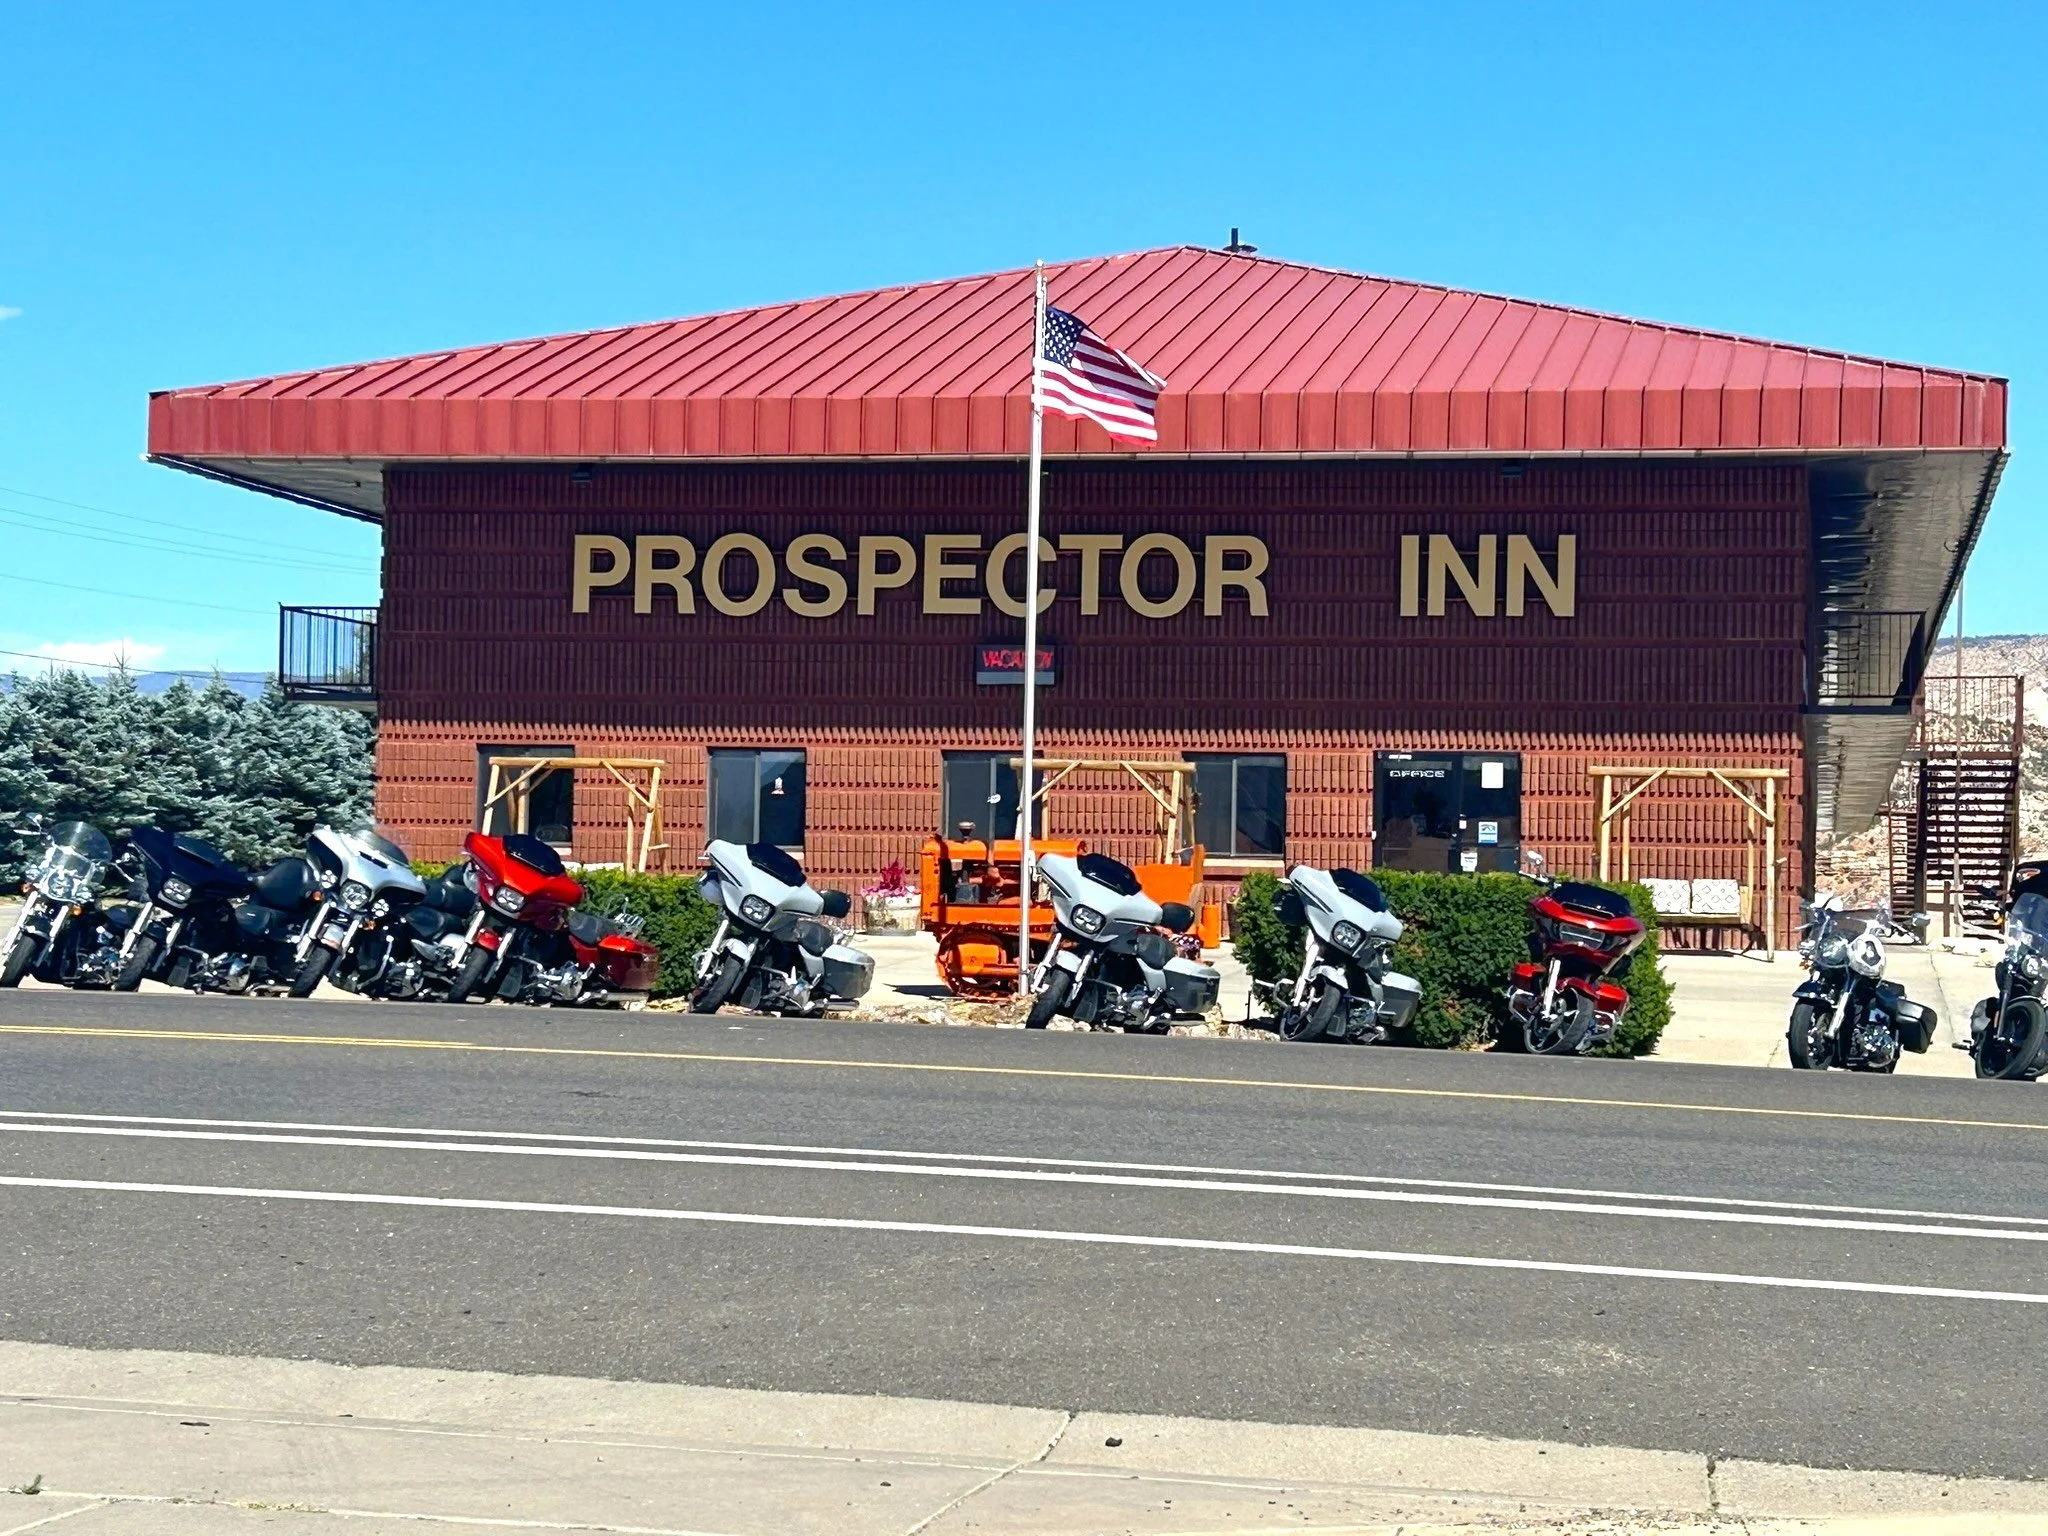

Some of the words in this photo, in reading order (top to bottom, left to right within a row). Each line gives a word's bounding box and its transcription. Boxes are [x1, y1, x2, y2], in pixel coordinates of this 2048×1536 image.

[572, 532, 1269, 617] PROSPECTOR
[1400, 534, 1576, 617] INN
[982, 649, 1054, 669] VACACY
[1389, 769, 1445, 778] OFFICE
